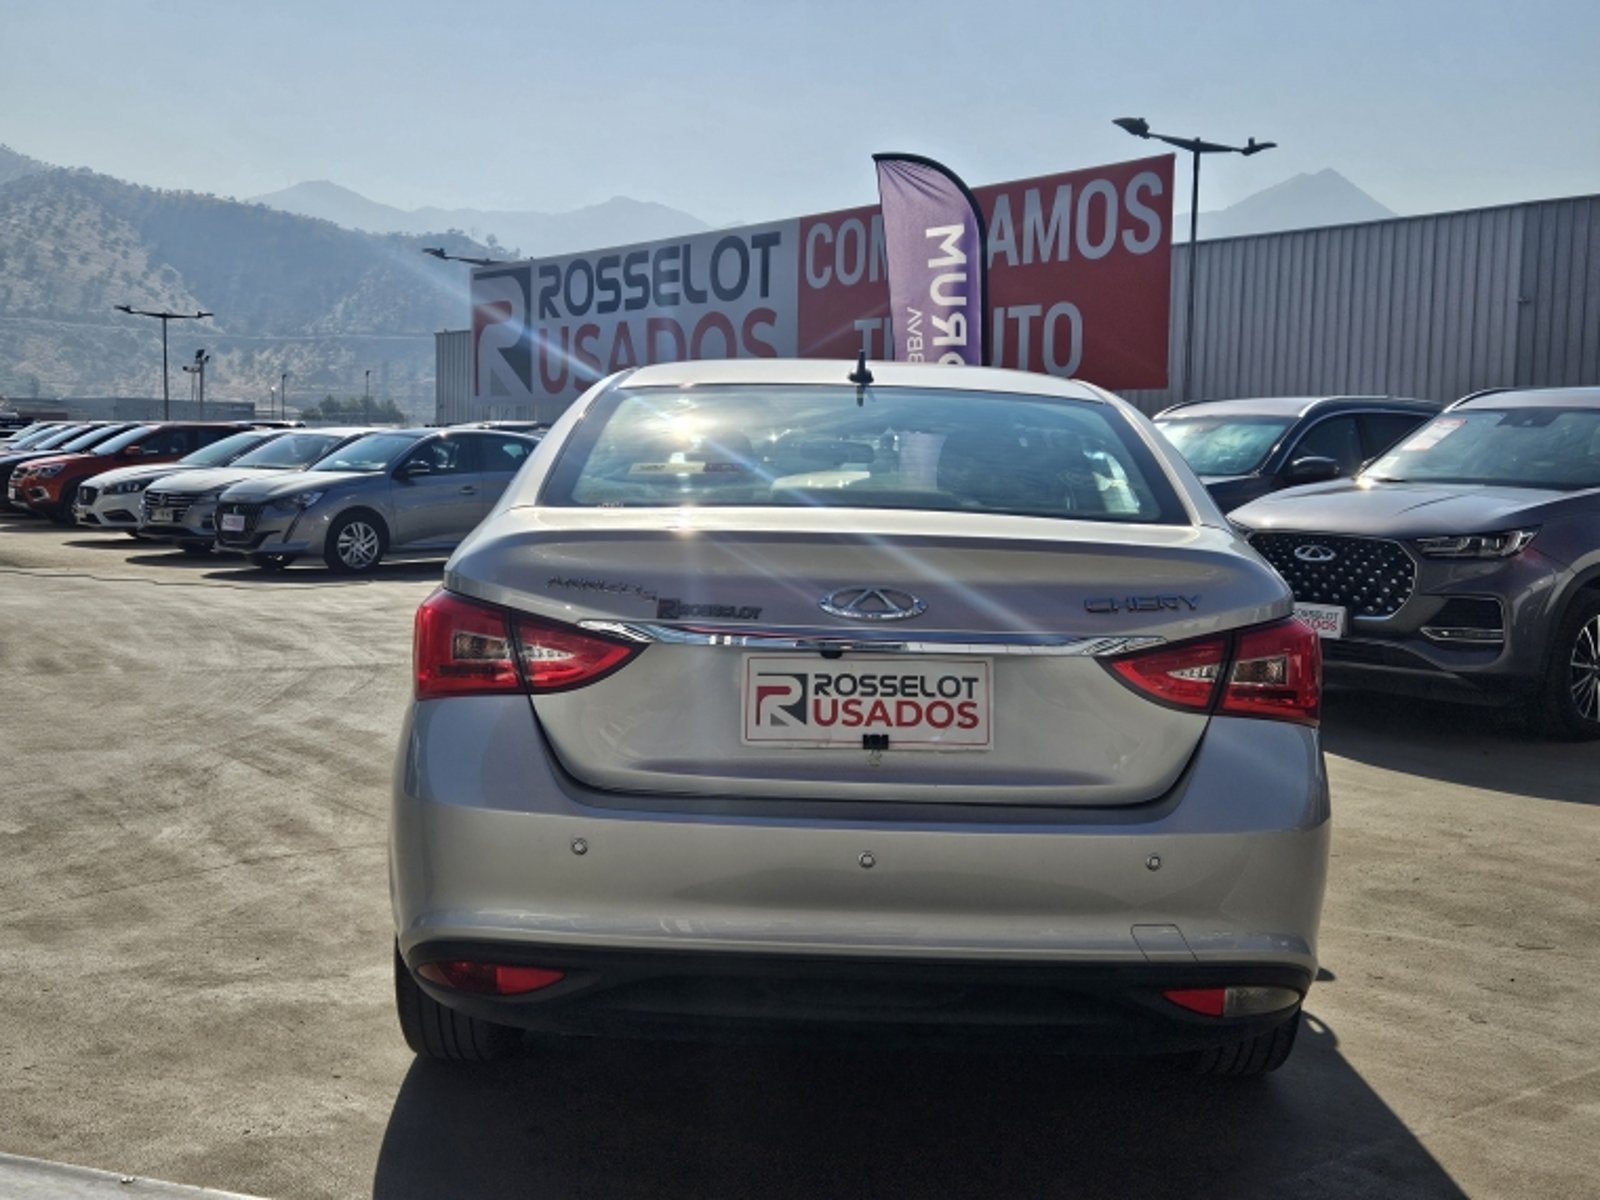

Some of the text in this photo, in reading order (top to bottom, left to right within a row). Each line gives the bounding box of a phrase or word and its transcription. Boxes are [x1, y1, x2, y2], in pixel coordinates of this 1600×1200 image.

[538, 231, 781, 320] ROSSELOT
[537, 307, 778, 394] USADOS
[1083, 594, 1202, 613] CHERY
[814, 673, 979, 699] ROSSELOT
[813, 698, 979, 729] USADOS
